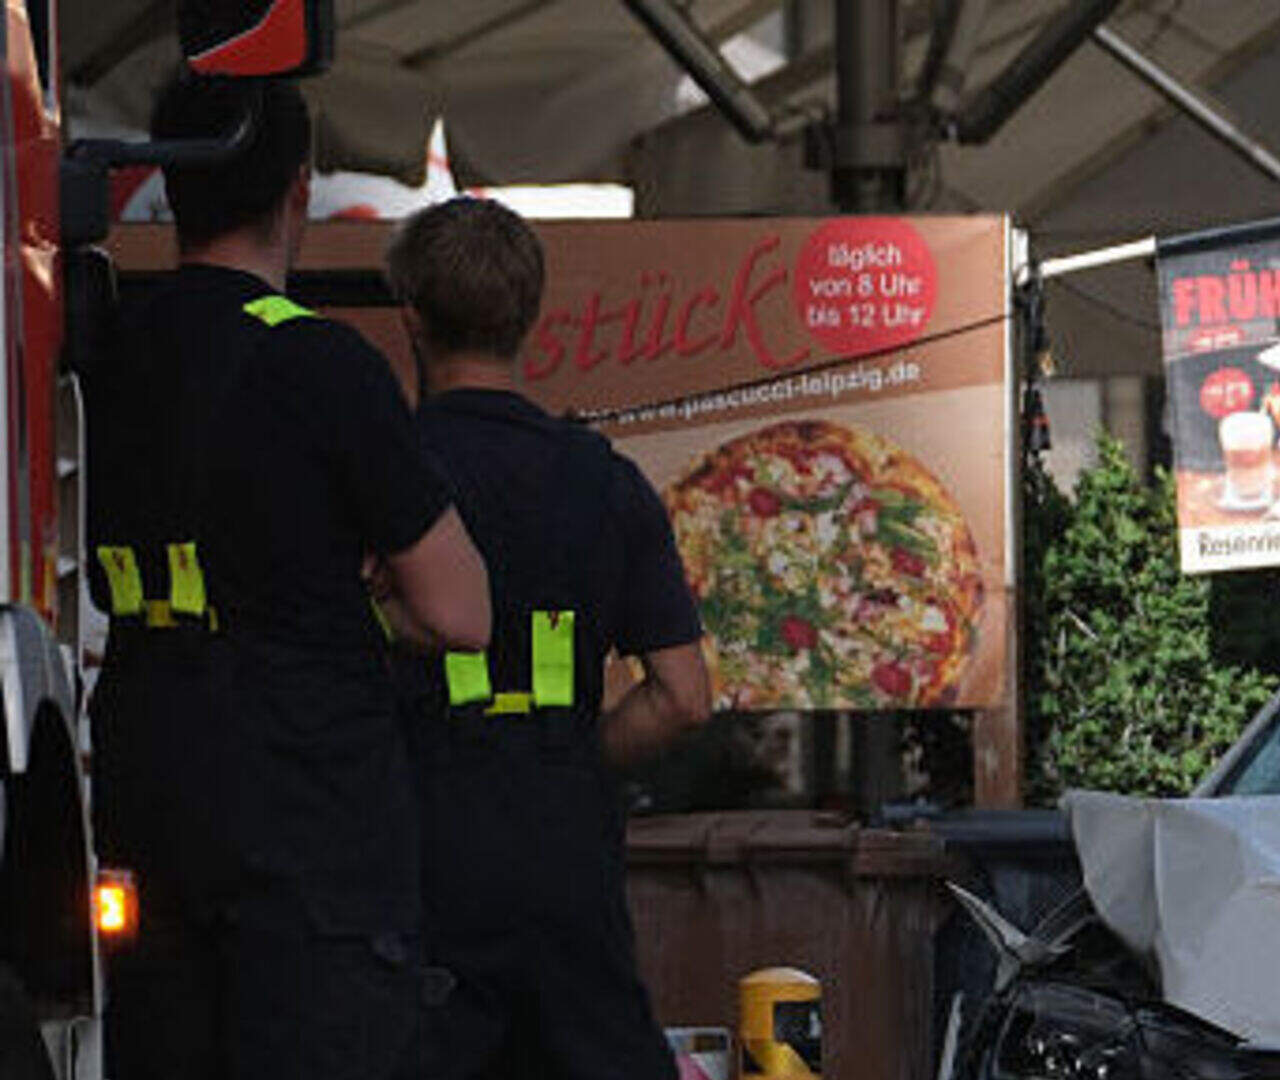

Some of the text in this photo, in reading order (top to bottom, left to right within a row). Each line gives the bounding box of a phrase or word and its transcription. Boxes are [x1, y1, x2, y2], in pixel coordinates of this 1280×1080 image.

[828, 242, 901, 271] täglich
[810, 273, 922, 298] von 8 Uhr
[808, 302, 925, 328] bis 12 Uhr
